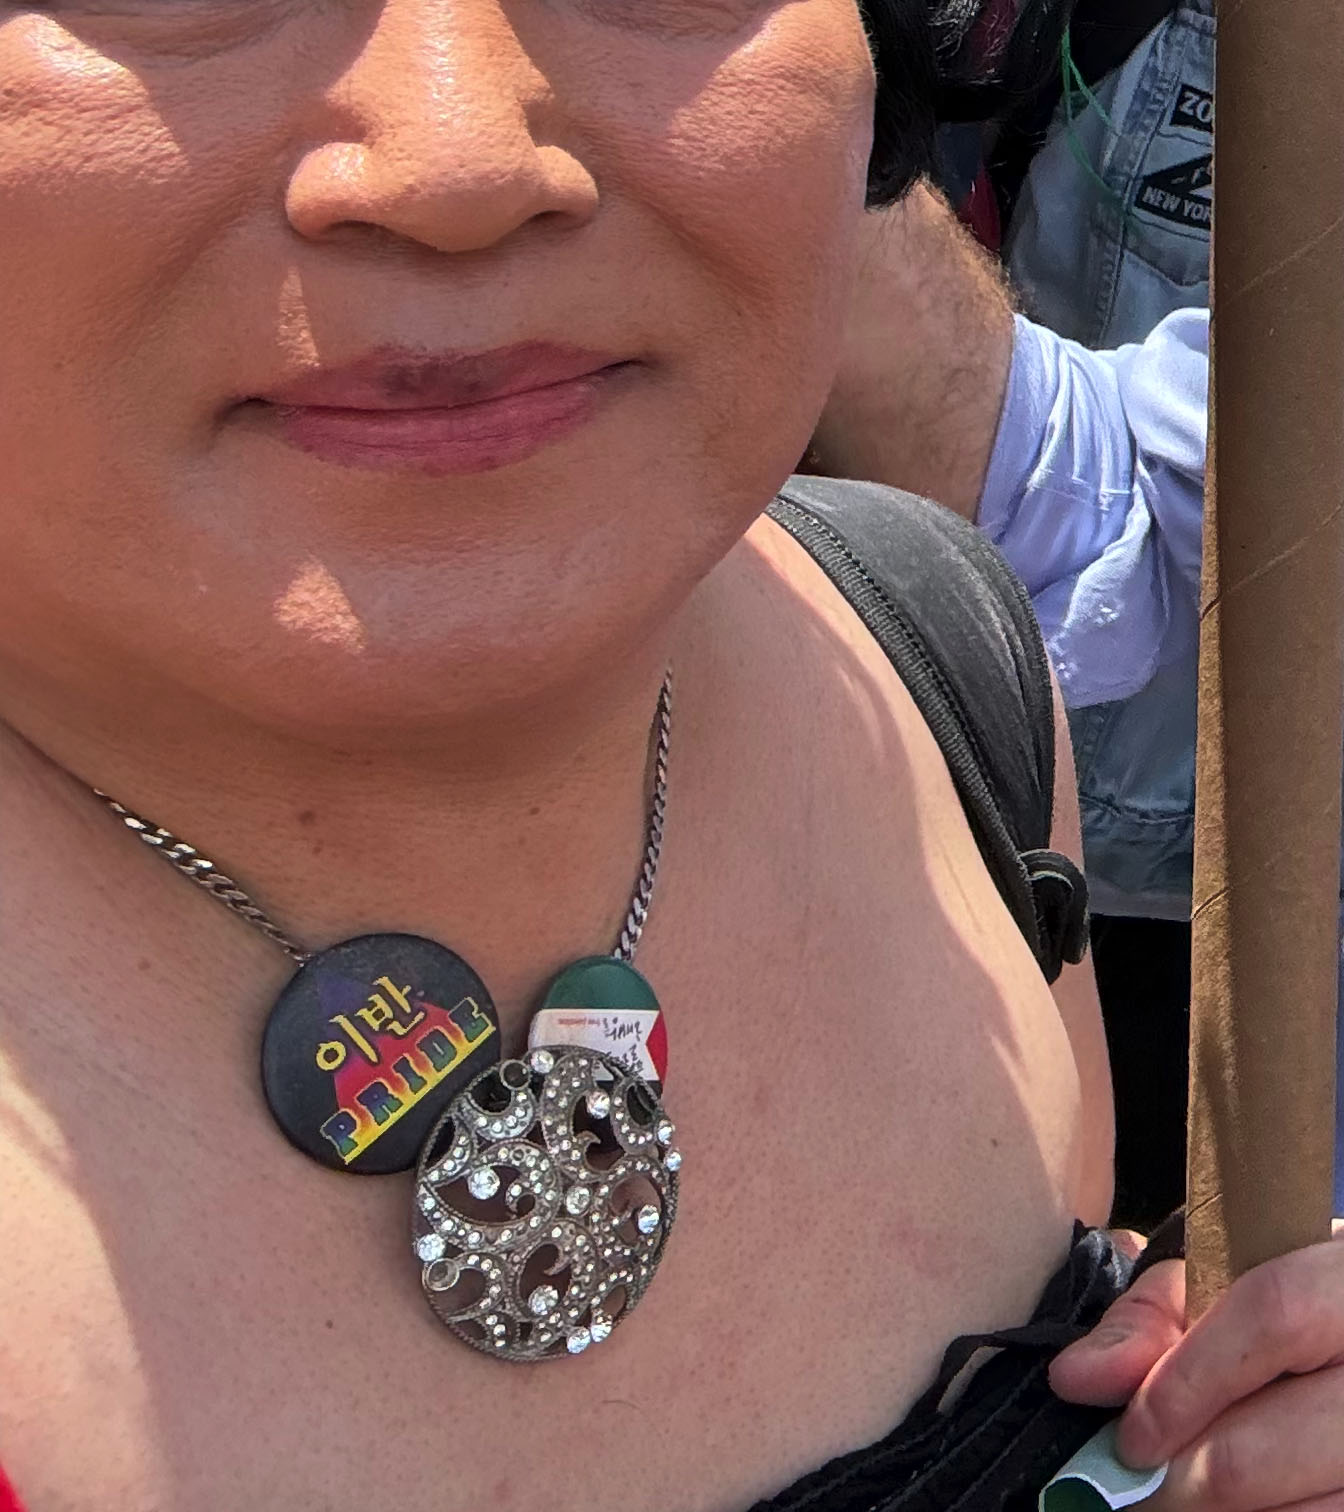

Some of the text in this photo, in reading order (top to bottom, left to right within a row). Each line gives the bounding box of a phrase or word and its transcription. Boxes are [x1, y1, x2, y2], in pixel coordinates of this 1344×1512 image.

[1142, 186, 1181, 213] NEW
[315, 974, 426, 1074] 이반
[320, 996, 495, 1160] PRIDE
